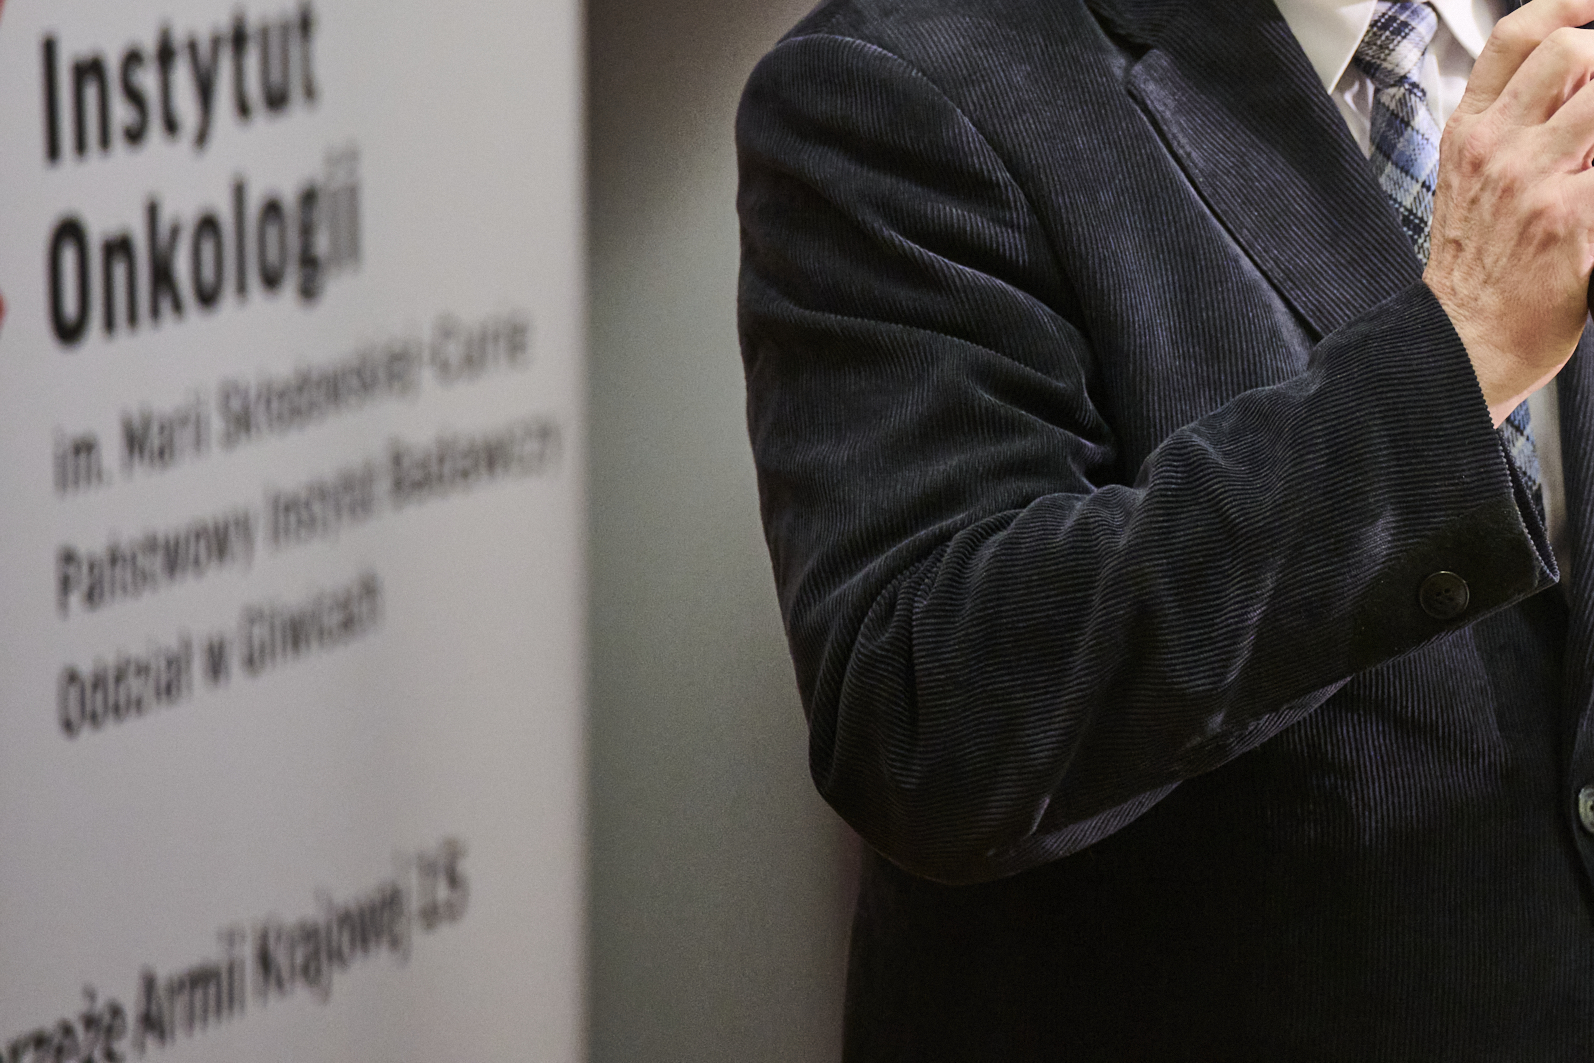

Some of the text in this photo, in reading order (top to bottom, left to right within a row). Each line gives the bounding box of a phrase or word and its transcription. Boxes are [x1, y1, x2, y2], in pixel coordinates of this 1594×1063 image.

[48, 142, 361, 349] Onkologii
[54, 429, 111, 497] im.
[120, 389, 211, 480] Marii
[203, 633, 231, 687] w
[132, 927, 246, 1057] Armii
[252, 849, 412, 1004] Krajowej
